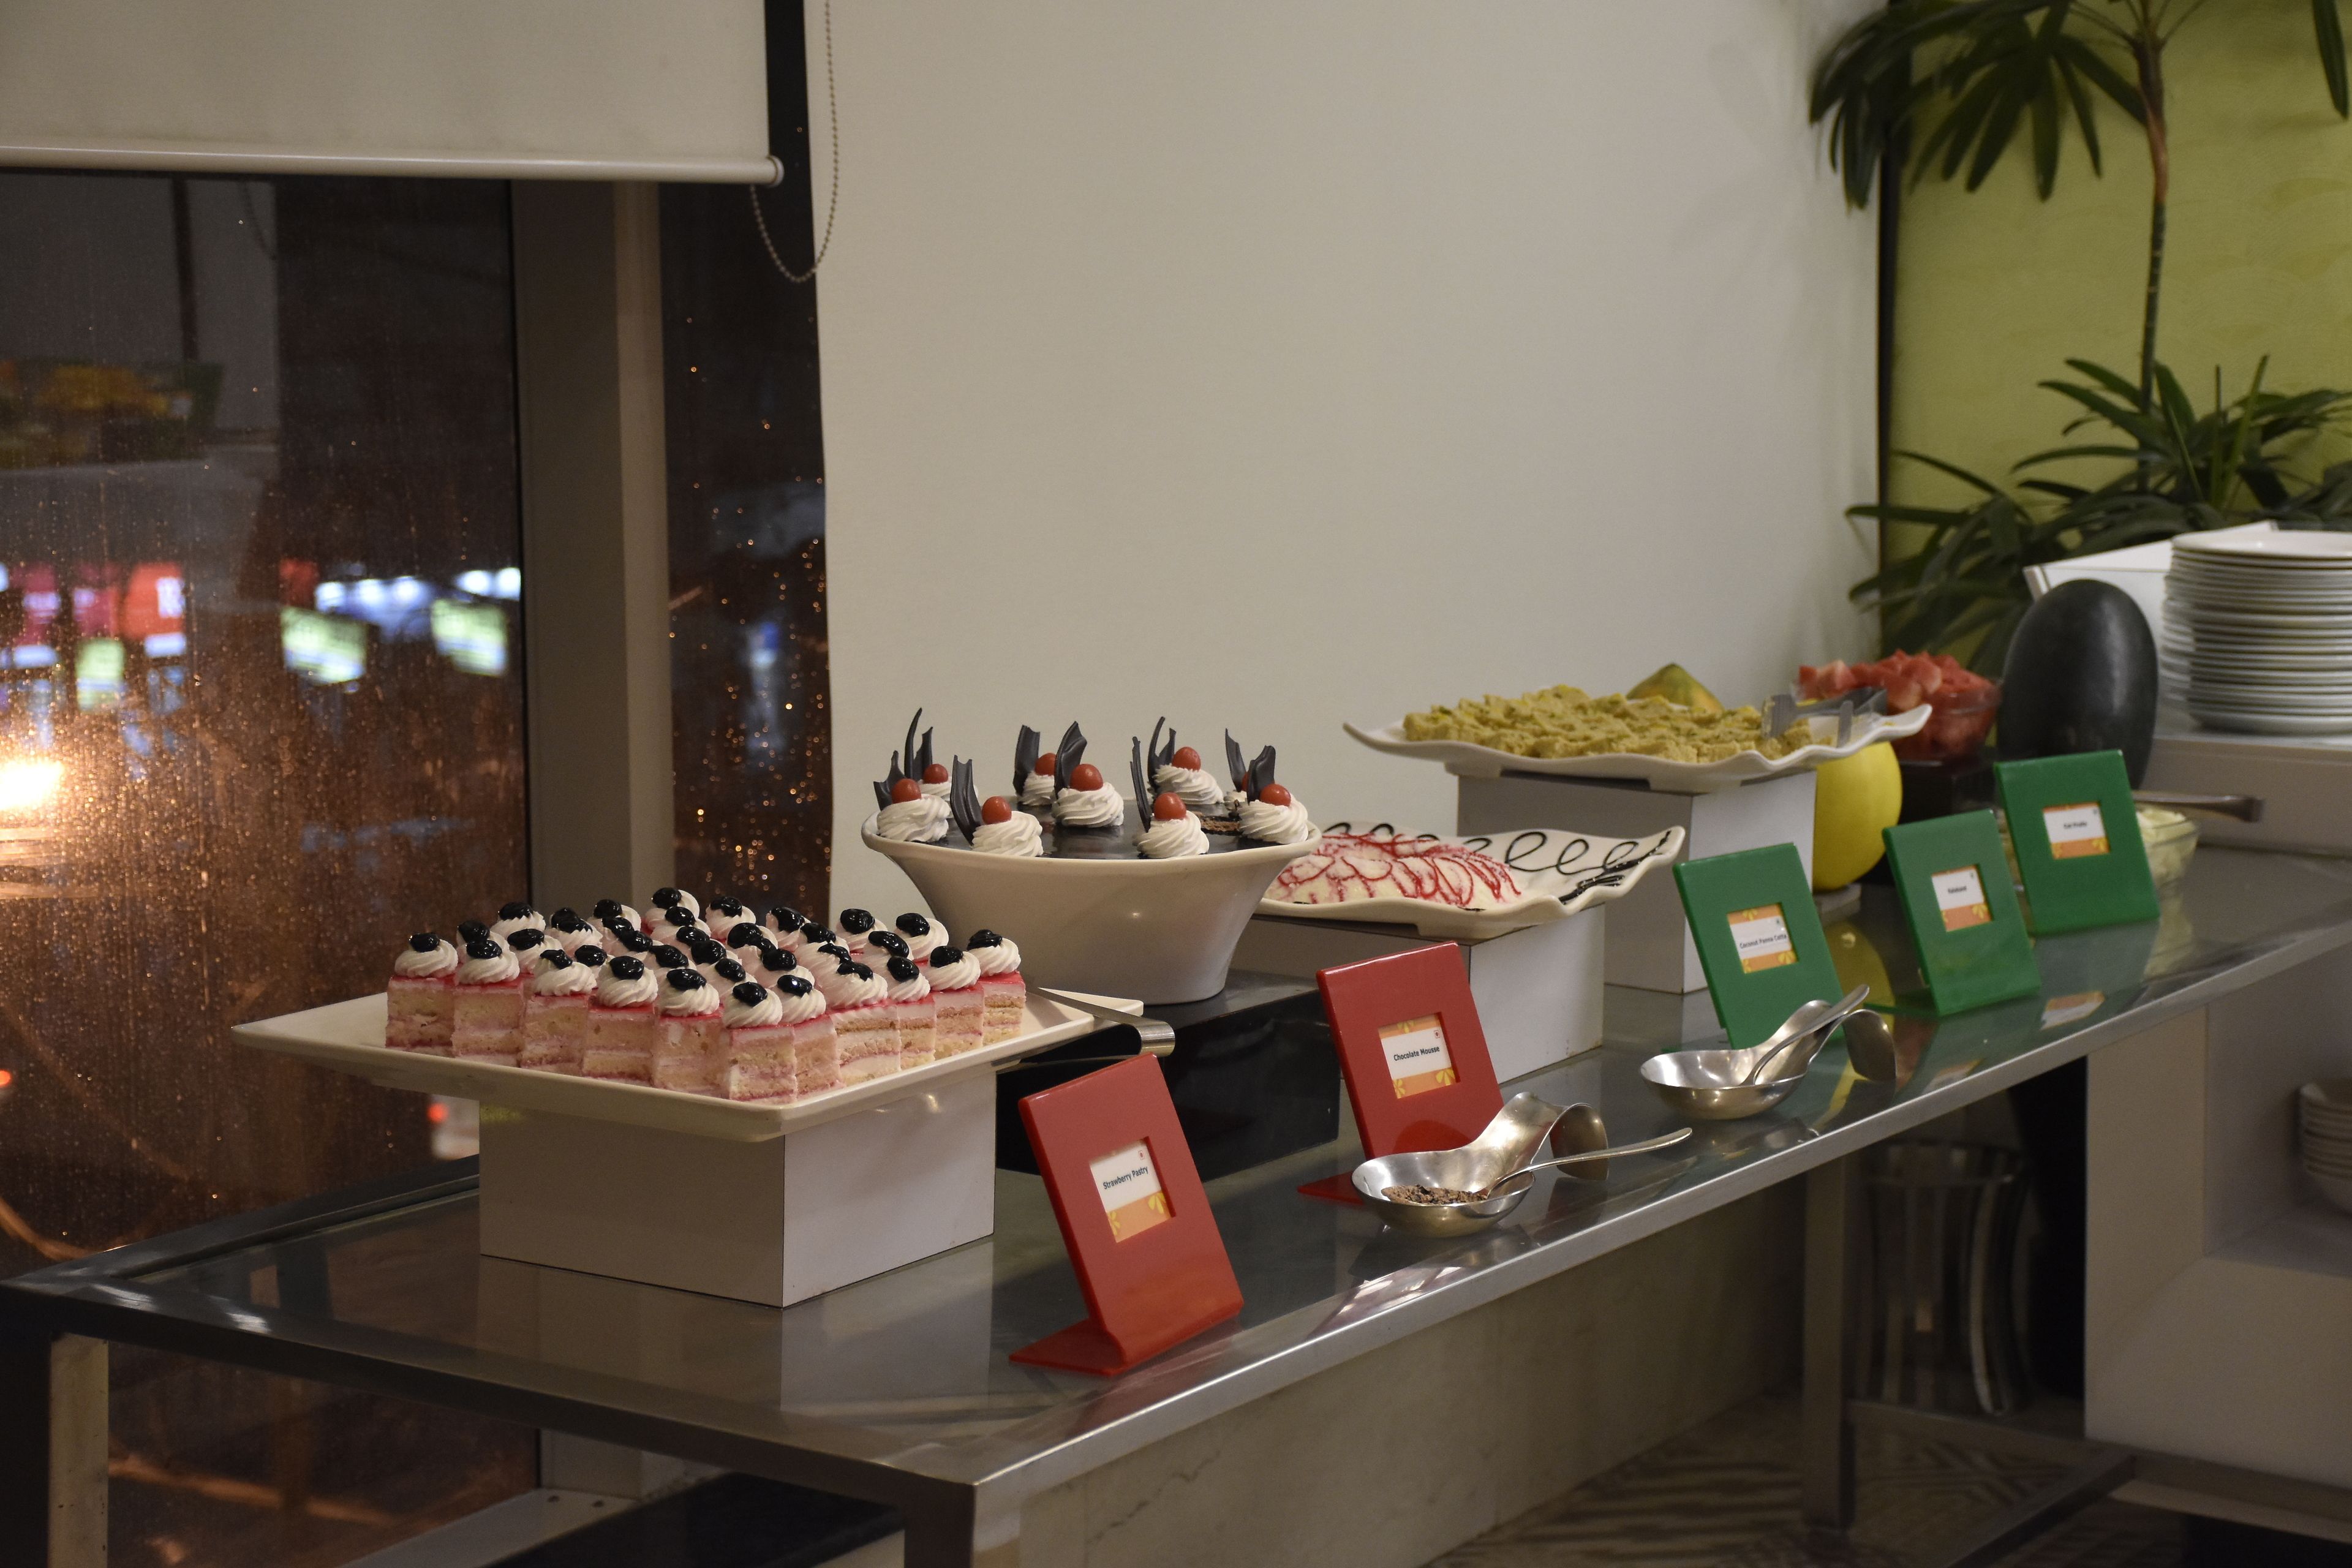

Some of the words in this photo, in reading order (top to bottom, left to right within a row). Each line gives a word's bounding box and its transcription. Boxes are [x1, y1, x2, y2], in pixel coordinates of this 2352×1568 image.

[1393, 1050, 1420, 1061] Chocolate
[1420, 1046, 1440, 1055] Mousse
[1102, 1172, 1132, 1189] Strawberry
[1132, 1166, 1148, 1178] Pastry
